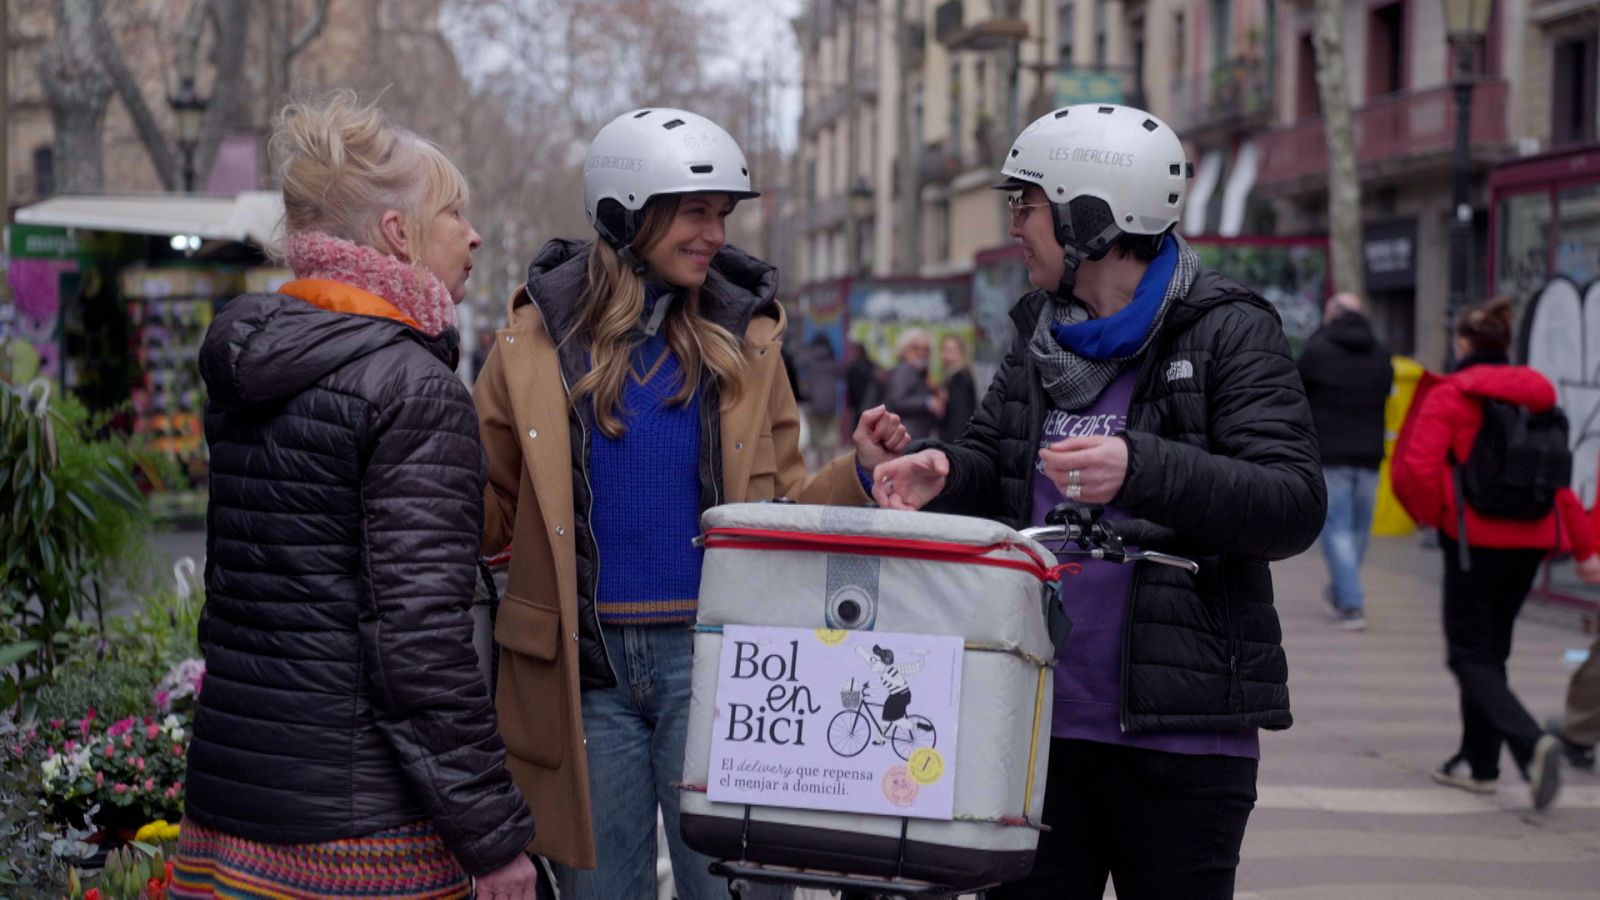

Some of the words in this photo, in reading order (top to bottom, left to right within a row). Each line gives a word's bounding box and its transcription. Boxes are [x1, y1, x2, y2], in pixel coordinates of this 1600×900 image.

[600, 156, 643, 172] MERCEDES
[1049, 147, 1071, 161] LES
[1072, 148, 1134, 167] MERCEDES
[731, 640, 799, 683] Bol
[766, 684, 821, 714] en
[725, 702, 805, 746] Bici
[721, 758, 733, 770] El
[736, 759, 795, 777] delivery
[796, 765, 820, 778] que
[823, 767, 873, 781] repensa
[719, 774, 731, 787] el
[734, 777, 779, 791] menjar
[782, 782, 789, 791] a
[793, 779, 850, 796] domicili.
